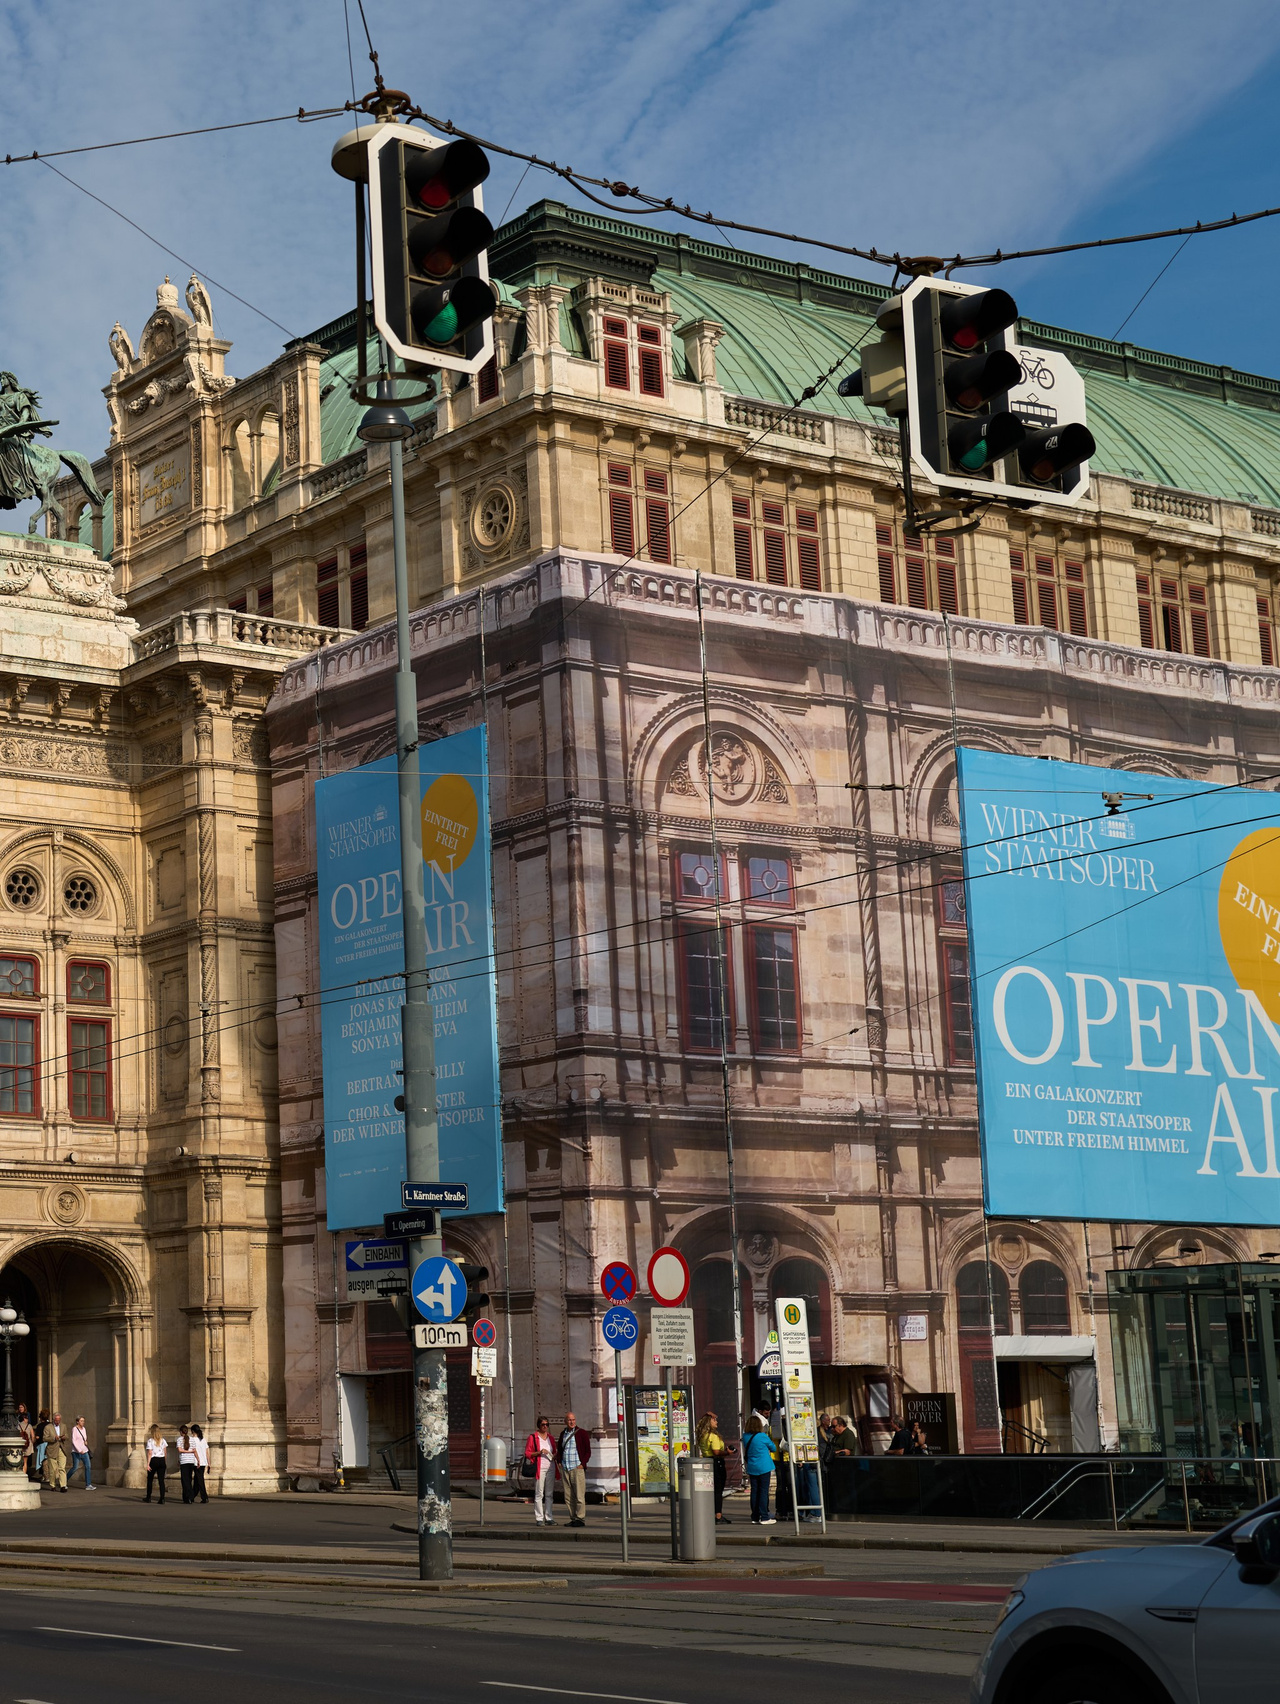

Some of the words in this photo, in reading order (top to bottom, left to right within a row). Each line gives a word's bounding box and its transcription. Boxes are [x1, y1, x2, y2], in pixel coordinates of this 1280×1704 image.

[328, 815, 373, 842] WIENER
[424, 809, 469, 838] EINTRITT
[980, 803, 1098, 850] WIENER
[329, 825, 397, 860] STAATSOPER
[435, 831, 459, 850] FREI
[984, 839, 1160, 893] STAATSOPER
[334, 934, 345, 944] EIN
[345, 924, 387, 941] GALAKONZERT
[354, 939, 370, 949] DER
[371, 930, 403, 947] STAATSOPER
[335, 953, 355, 964] UNTER
[355, 947, 378, 960] FREIEM
[378, 942, 403, 955] HIMMEL
[342, 1013, 399, 1039] BENJAMIN
[435, 999, 468, 1019] HEIM
[350, 998, 384, 1021] JONAS
[351, 1034, 390, 1054] SONYA
[390, 1059, 404, 1070] Diri
[347, 1074, 404, 1096] BERTRAN
[1005, 1082, 1031, 1099] EIN
[1035, 1085, 1142, 1106] GALAKONZERT
[348, 1106, 380, 1123] CHOR
[383, 1104, 391, 1117] &
[439, 1107, 485, 1127] TSOPER
[1067, 1110, 1097, 1126] DER
[1100, 1112, 1192, 1132] STAATSOPER
[333, 1130, 355, 1144] DER
[358, 1120, 405, 1139] WIENER
[1013, 1129, 1064, 1147] UNTER
[1067, 1132, 1124, 1150] FREIEM
[1128, 1136, 1189, 1154] HIMMEL
[413, 1190, 443, 1201] Kärntner
[444, 1191, 466, 1202] Straße
[398, 1218, 426, 1232] Opernring
[365, 1247, 401, 1262] EINBAHN
[348, 1278, 377, 1294] ausgen.
[609, 1297, 630, 1305] ANFANG
[908, 1400, 942, 1412] OPERN
[909, 1411, 942, 1423] FOYER
